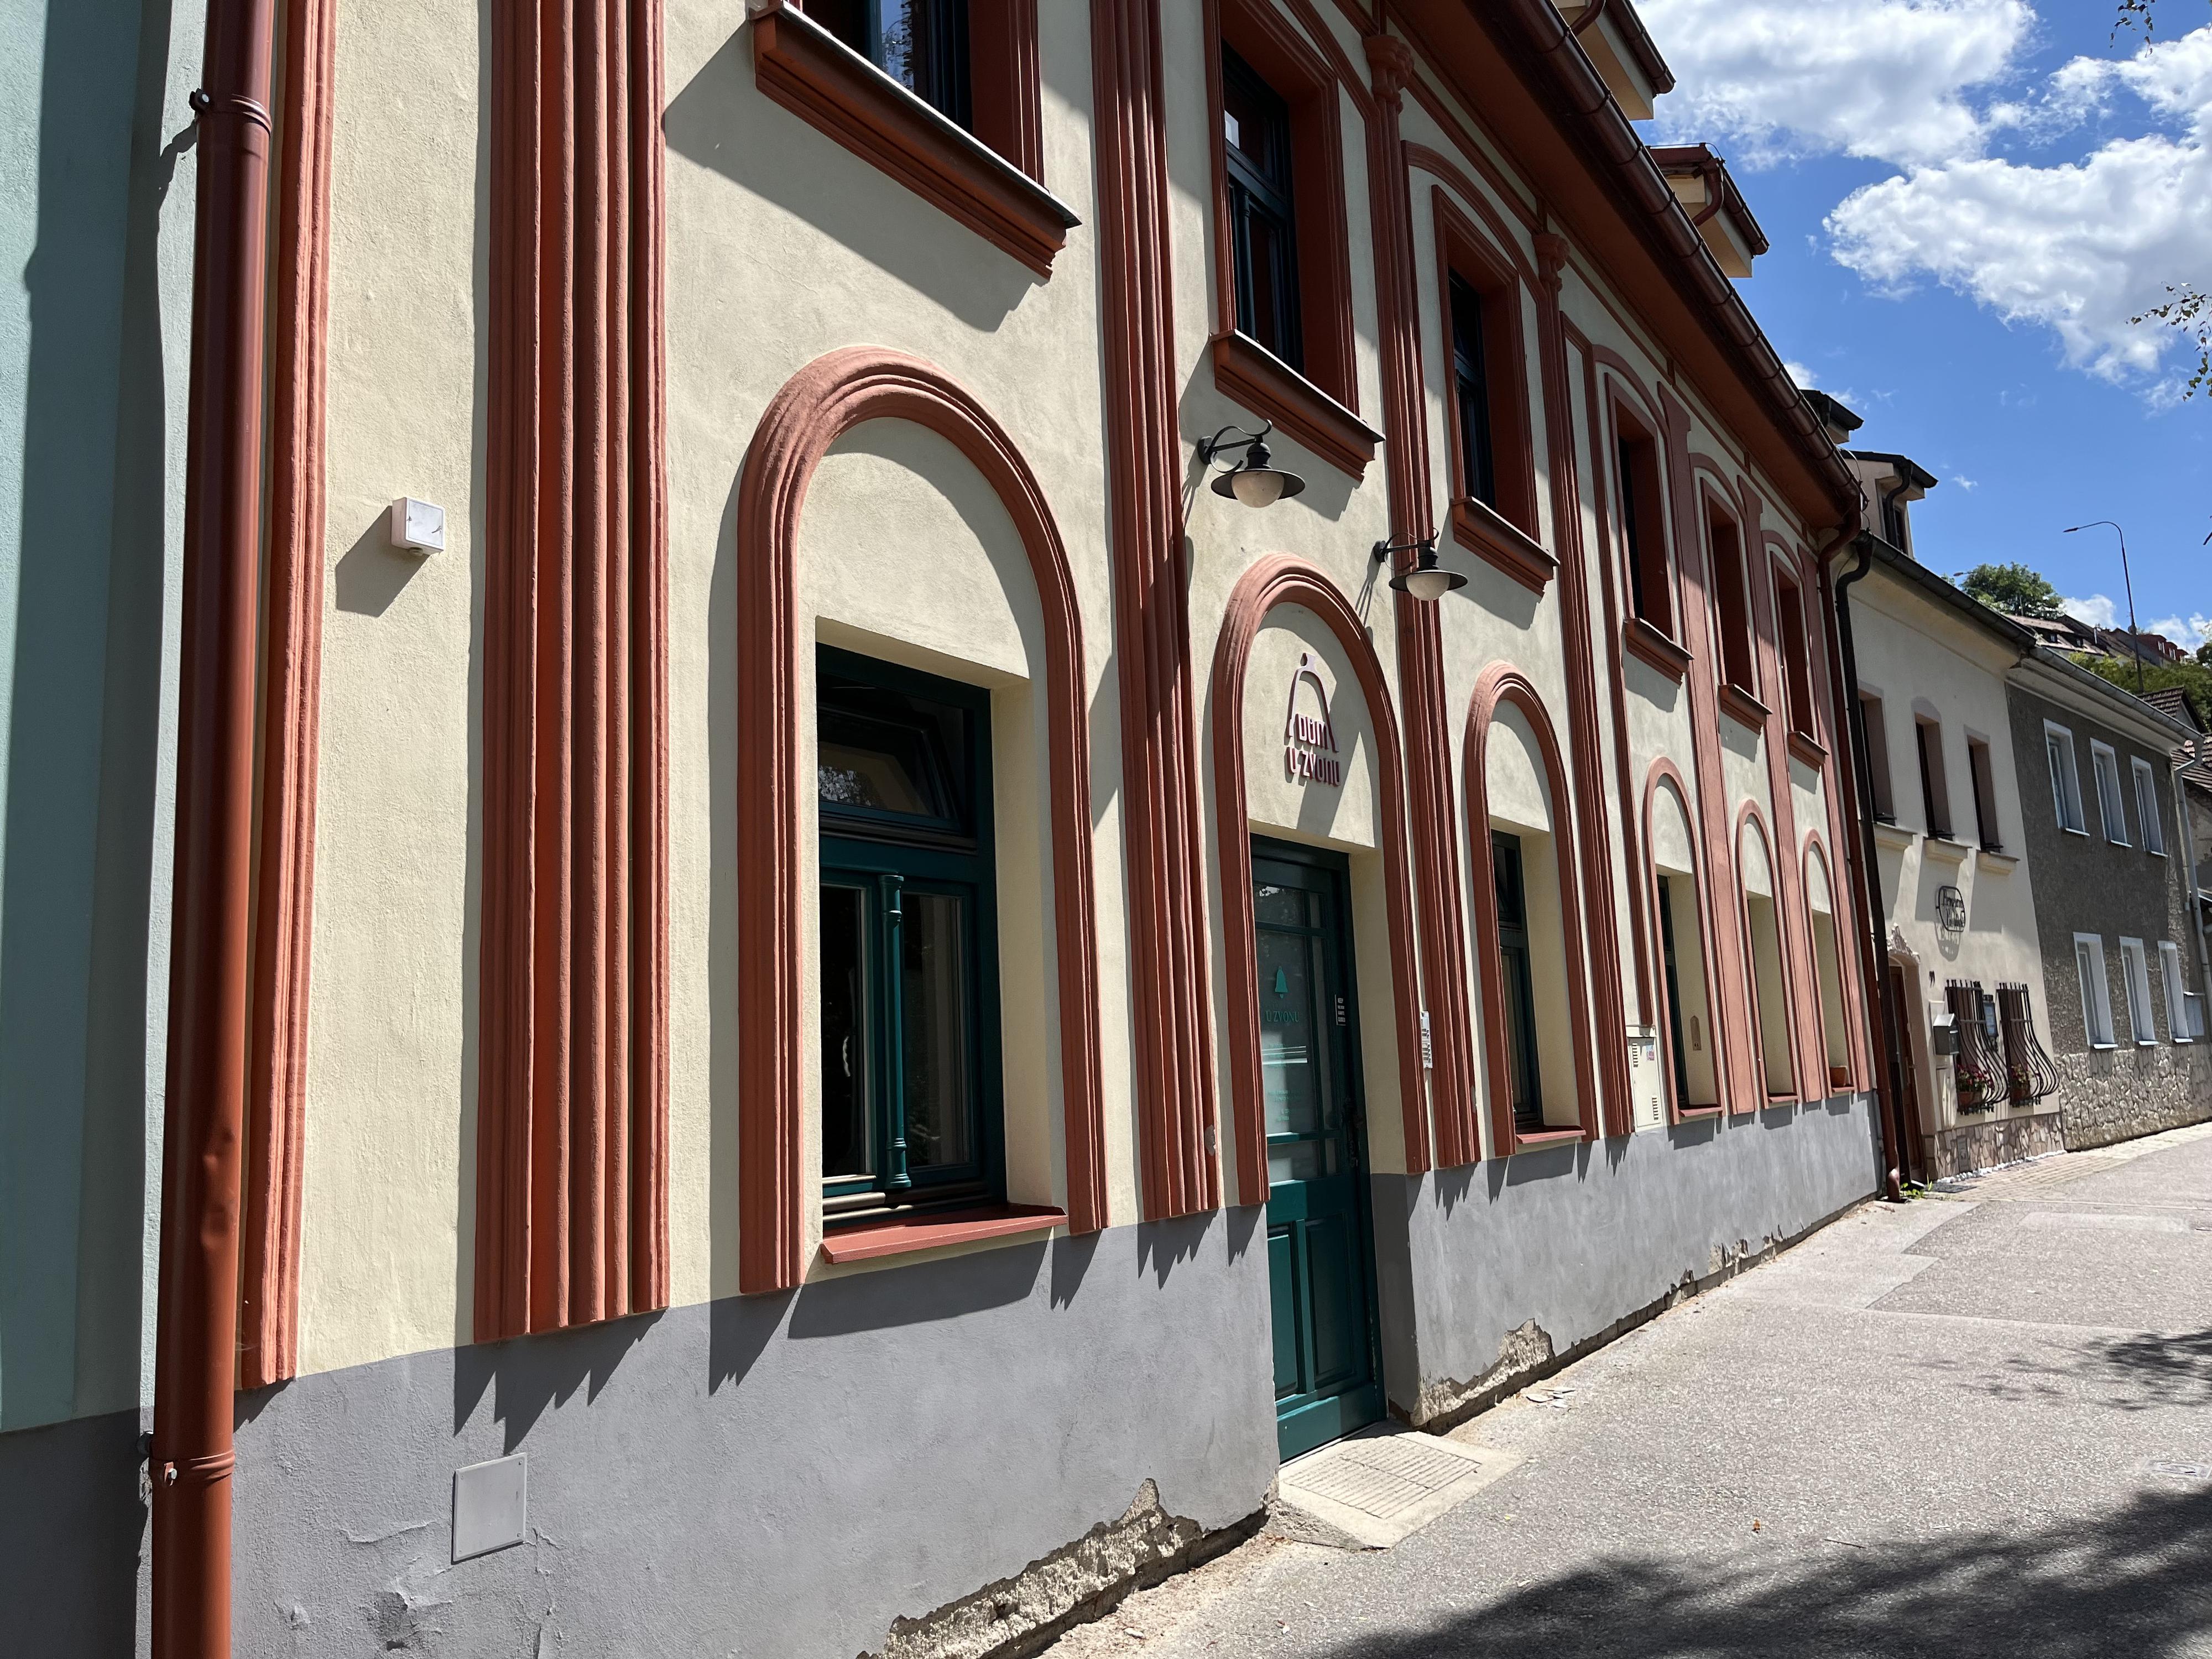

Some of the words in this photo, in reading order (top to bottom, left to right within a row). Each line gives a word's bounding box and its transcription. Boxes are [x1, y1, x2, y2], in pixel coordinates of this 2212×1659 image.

[1286, 747, 1298, 775] U
[1300, 751, 1340, 787] ZVONU
[1265, 1010, 1272, 1022] U
[1274, 1010, 1301, 1023] ZVONU
